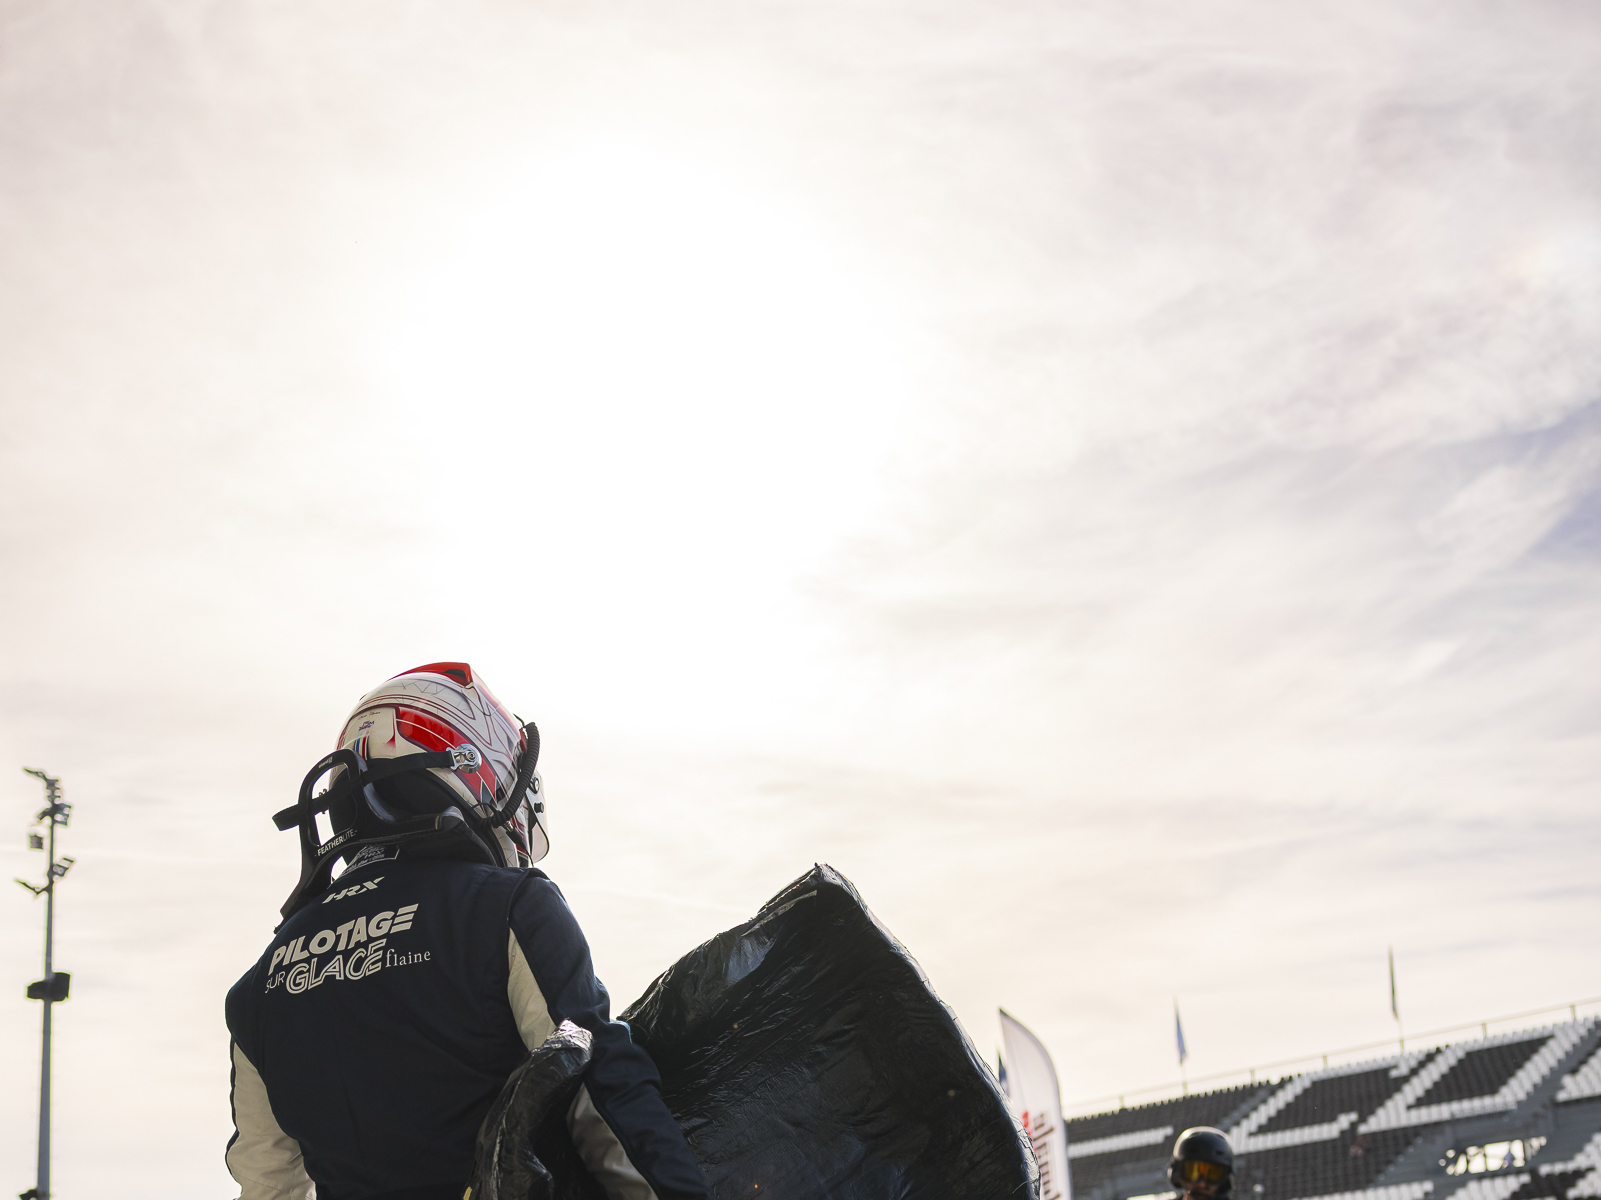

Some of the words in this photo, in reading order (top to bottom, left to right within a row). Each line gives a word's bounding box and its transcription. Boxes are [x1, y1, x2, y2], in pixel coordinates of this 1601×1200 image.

[322, 876, 385, 904] HRX
[265, 970, 286, 994] SUR
[286, 938, 387, 994] GLACE
[385, 948, 432, 968] flaine
[268, 903, 419, 976] PILOTAGE
